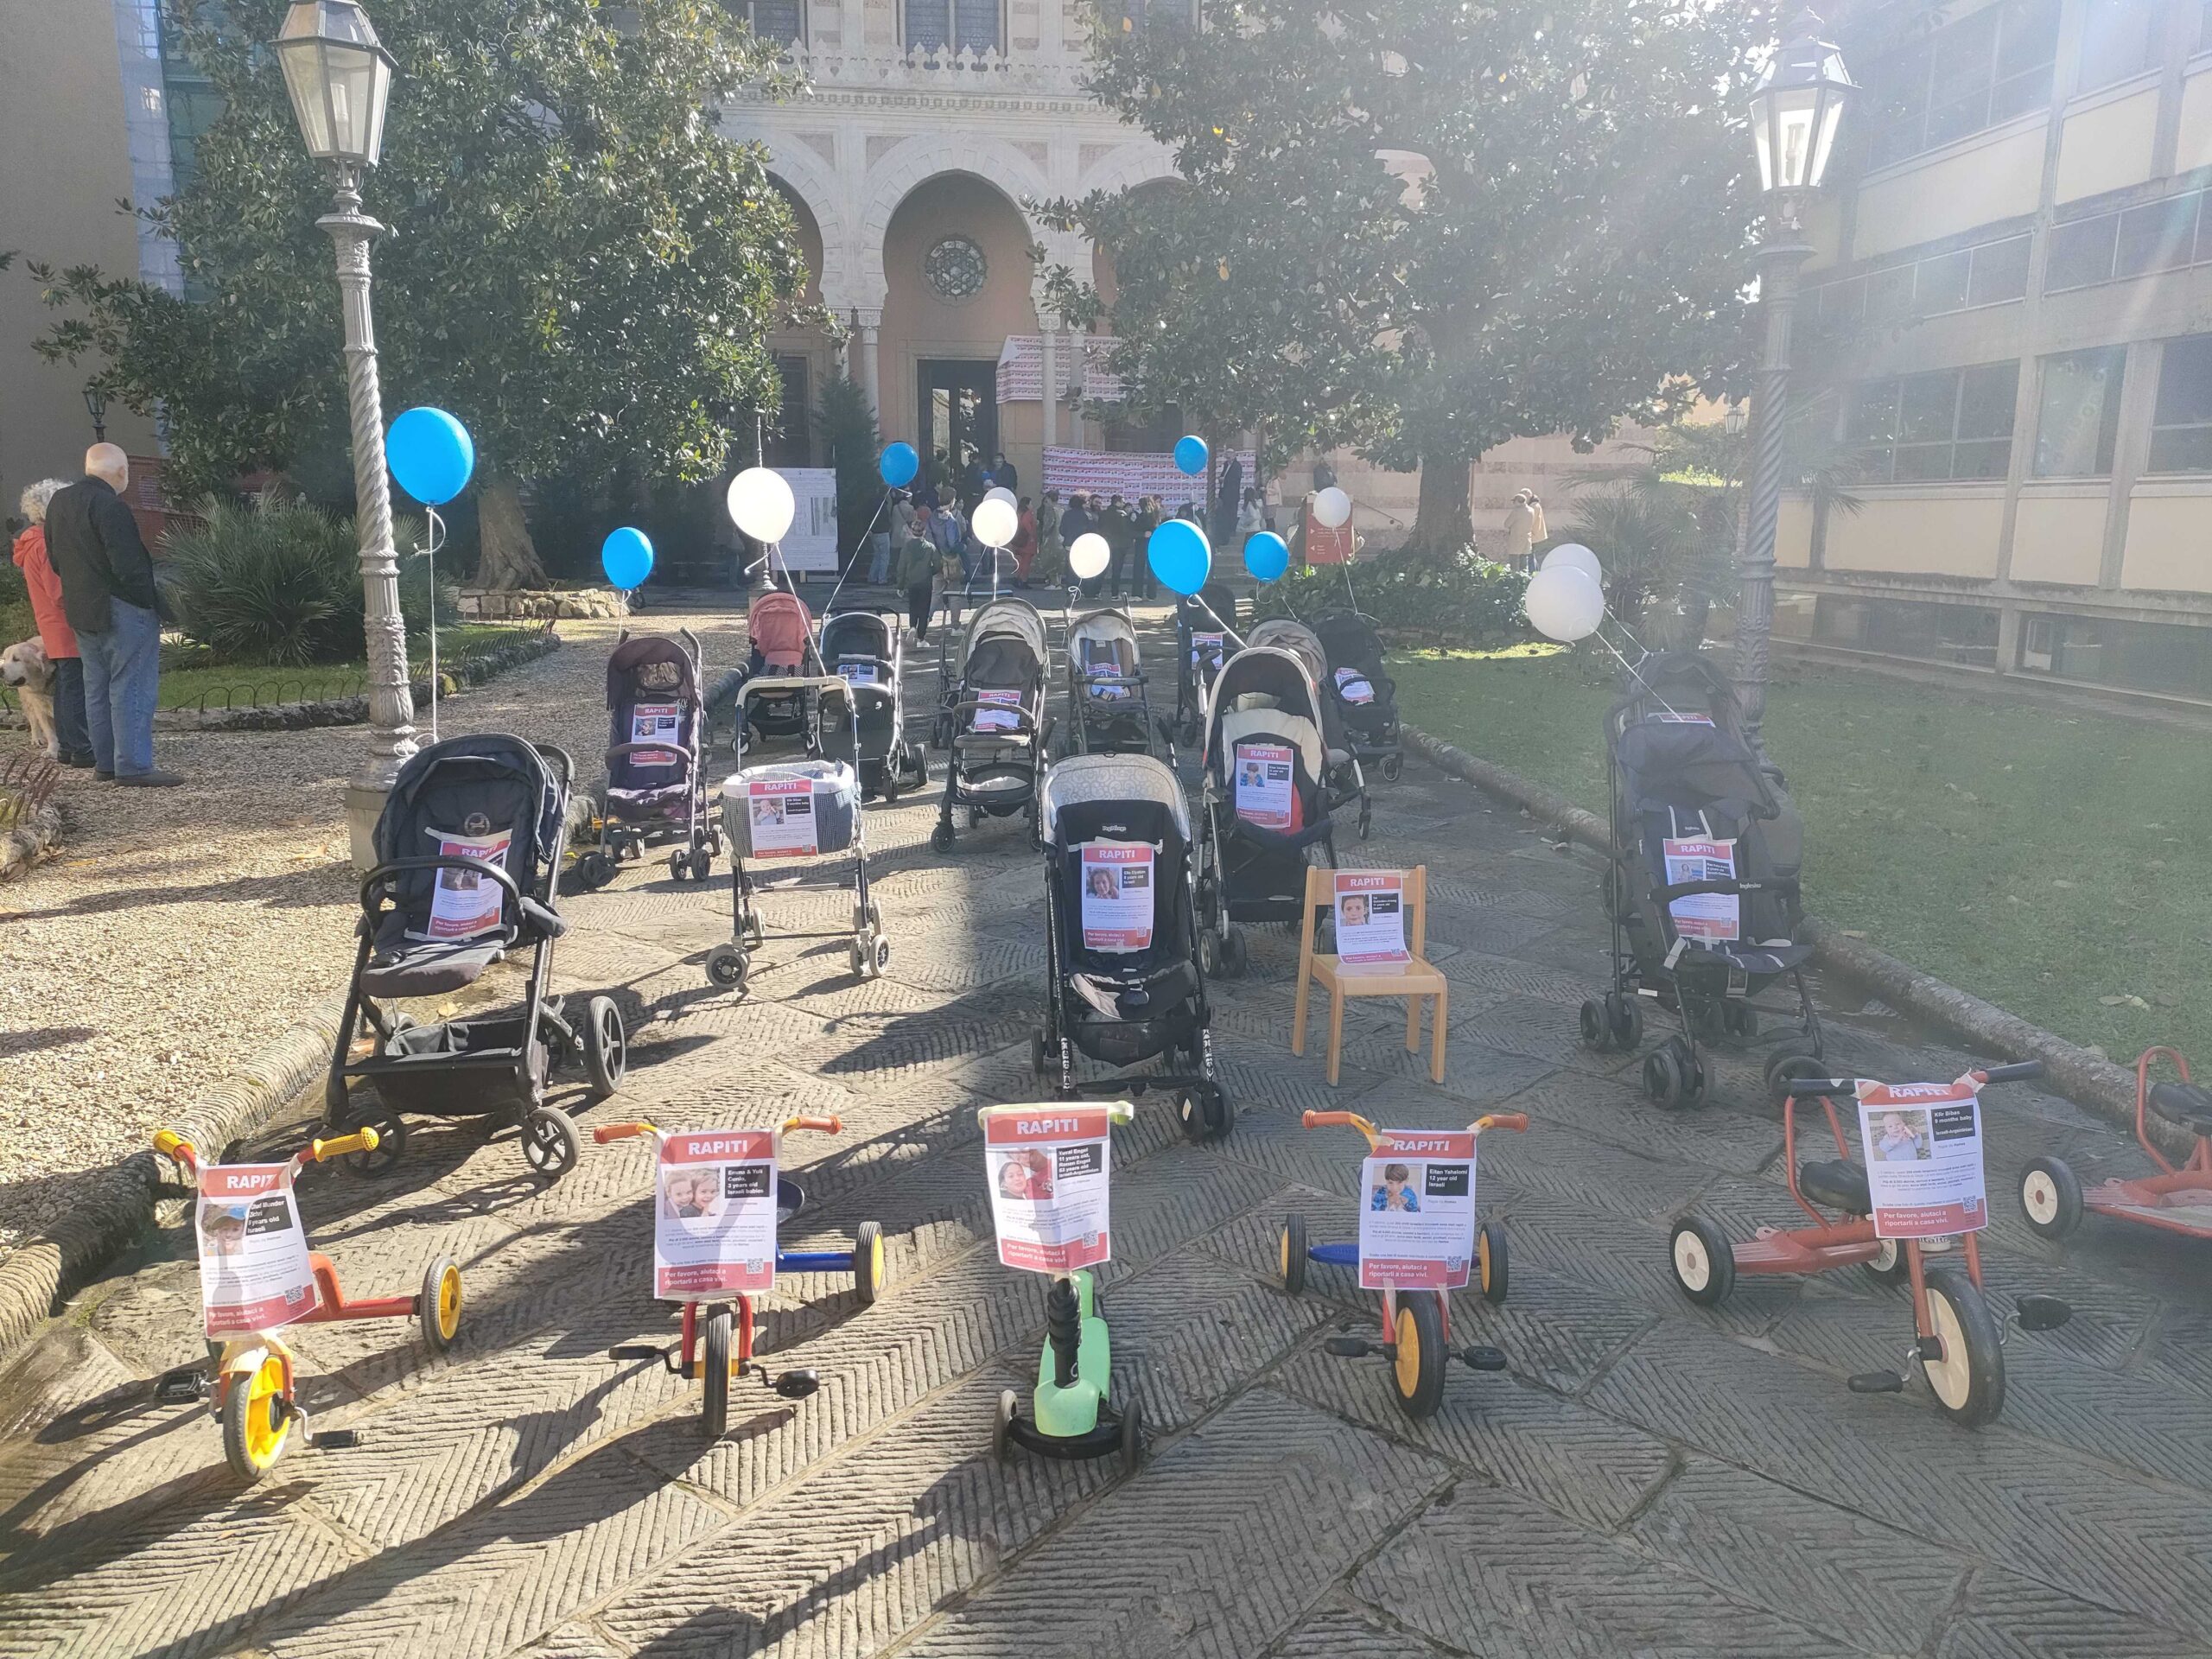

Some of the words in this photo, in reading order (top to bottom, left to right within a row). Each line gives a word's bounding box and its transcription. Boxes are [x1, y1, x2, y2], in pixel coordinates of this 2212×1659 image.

[1250, 750, 1279, 759] RAPITI
[764, 782, 797, 791] RAPITI
[461, 845, 498, 857] RAPITI
[1098, 849, 1135, 859] RAPITI
[1681, 844, 1715, 855] RAPITI
[1350, 877, 1384, 887] RAPITI
[1889, 1085, 1951, 1098] RAPITI
[1016, 1118, 1078, 1135] RAPITI
[689, 1140, 747, 1155] RAPITI
[1394, 1140, 1450, 1152] RAPITI
